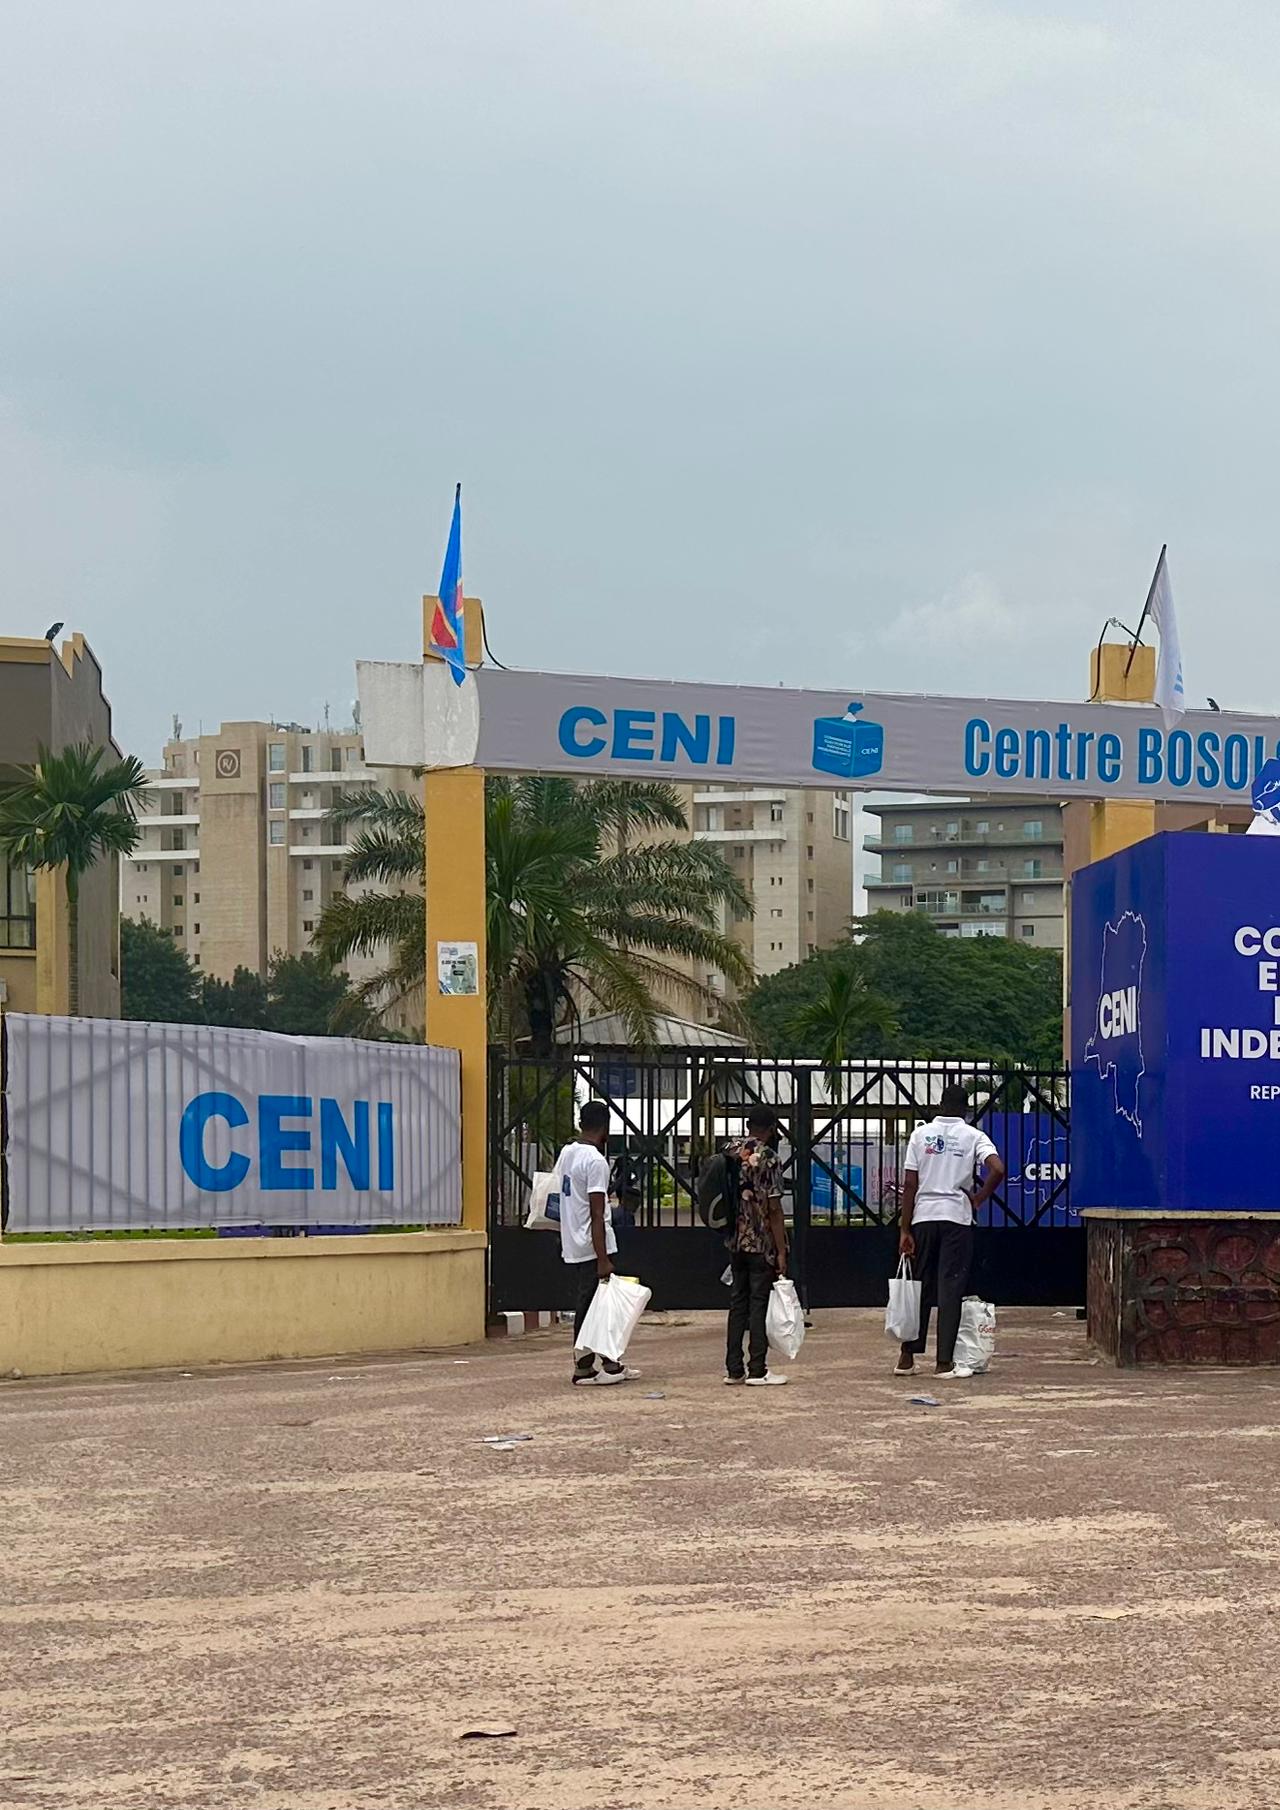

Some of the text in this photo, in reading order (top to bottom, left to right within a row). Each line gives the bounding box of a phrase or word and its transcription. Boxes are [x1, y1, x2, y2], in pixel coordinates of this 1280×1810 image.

[558, 705, 735, 765] CENI
[965, 718, 1122, 783] Centre
[1100, 985, 1136, 1040] CENI
[179, 1091, 394, 1192] CENI
